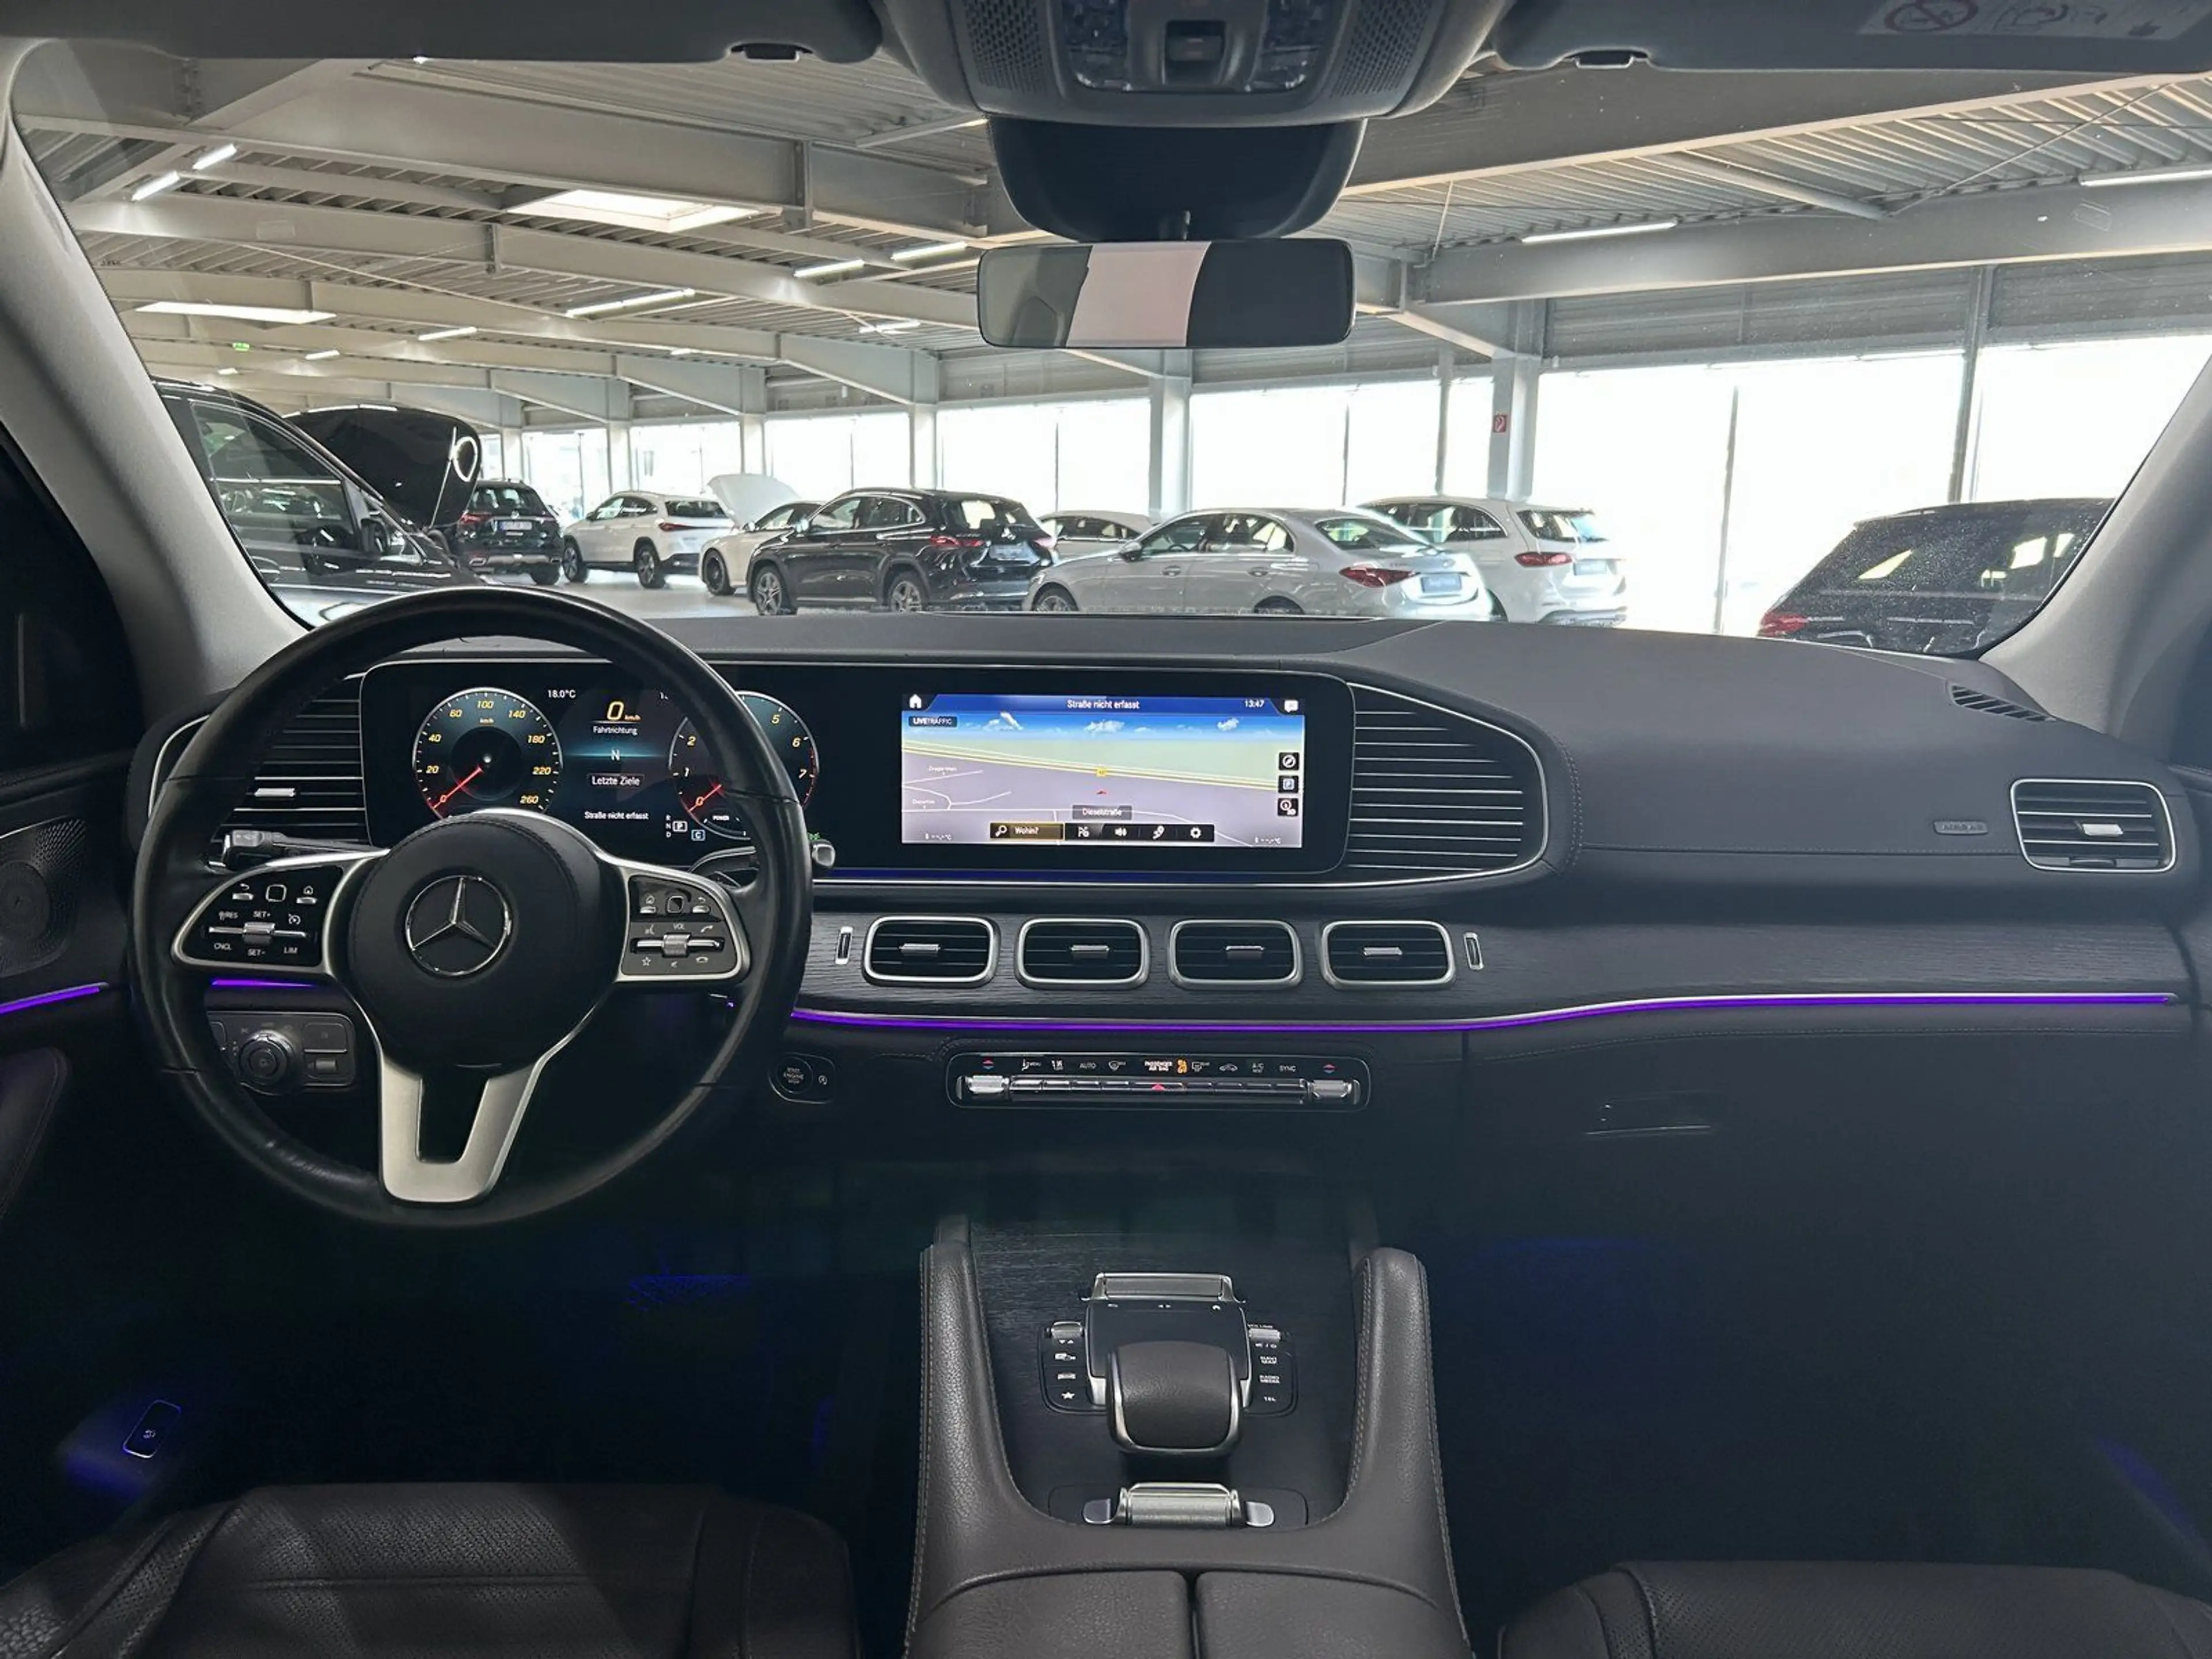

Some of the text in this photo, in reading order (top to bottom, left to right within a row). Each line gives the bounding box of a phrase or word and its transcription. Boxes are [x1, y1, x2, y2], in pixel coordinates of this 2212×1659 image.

[548, 690, 576, 698] 18.0°C
[477, 700, 494, 709] 100
[1067, 699, 1140, 710] Straße nicht erfasst
[1244, 699, 1264, 708] 13:47
[449, 709, 463, 718] 60
[509, 710, 526, 719] 140
[607, 700, 624, 721] 0
[771, 714, 780, 724] 5
[593, 725, 638, 736] Fahrtrichtung
[429, 734, 442, 743] 40
[528, 734, 546, 744] 180
[687, 736, 696, 747] 2
[791, 737, 801, 748] 6
[611, 749, 620, 761] N
[426, 765, 440, 774] 20
[532, 766, 552, 775] 220
[684, 767, 690, 777] 1
[798, 768, 807, 778] 7
[592, 775, 640, 786] Letzte Ziele
[520, 796, 539, 804] 260
[1015, 827, 1039, 835] Wohin?
